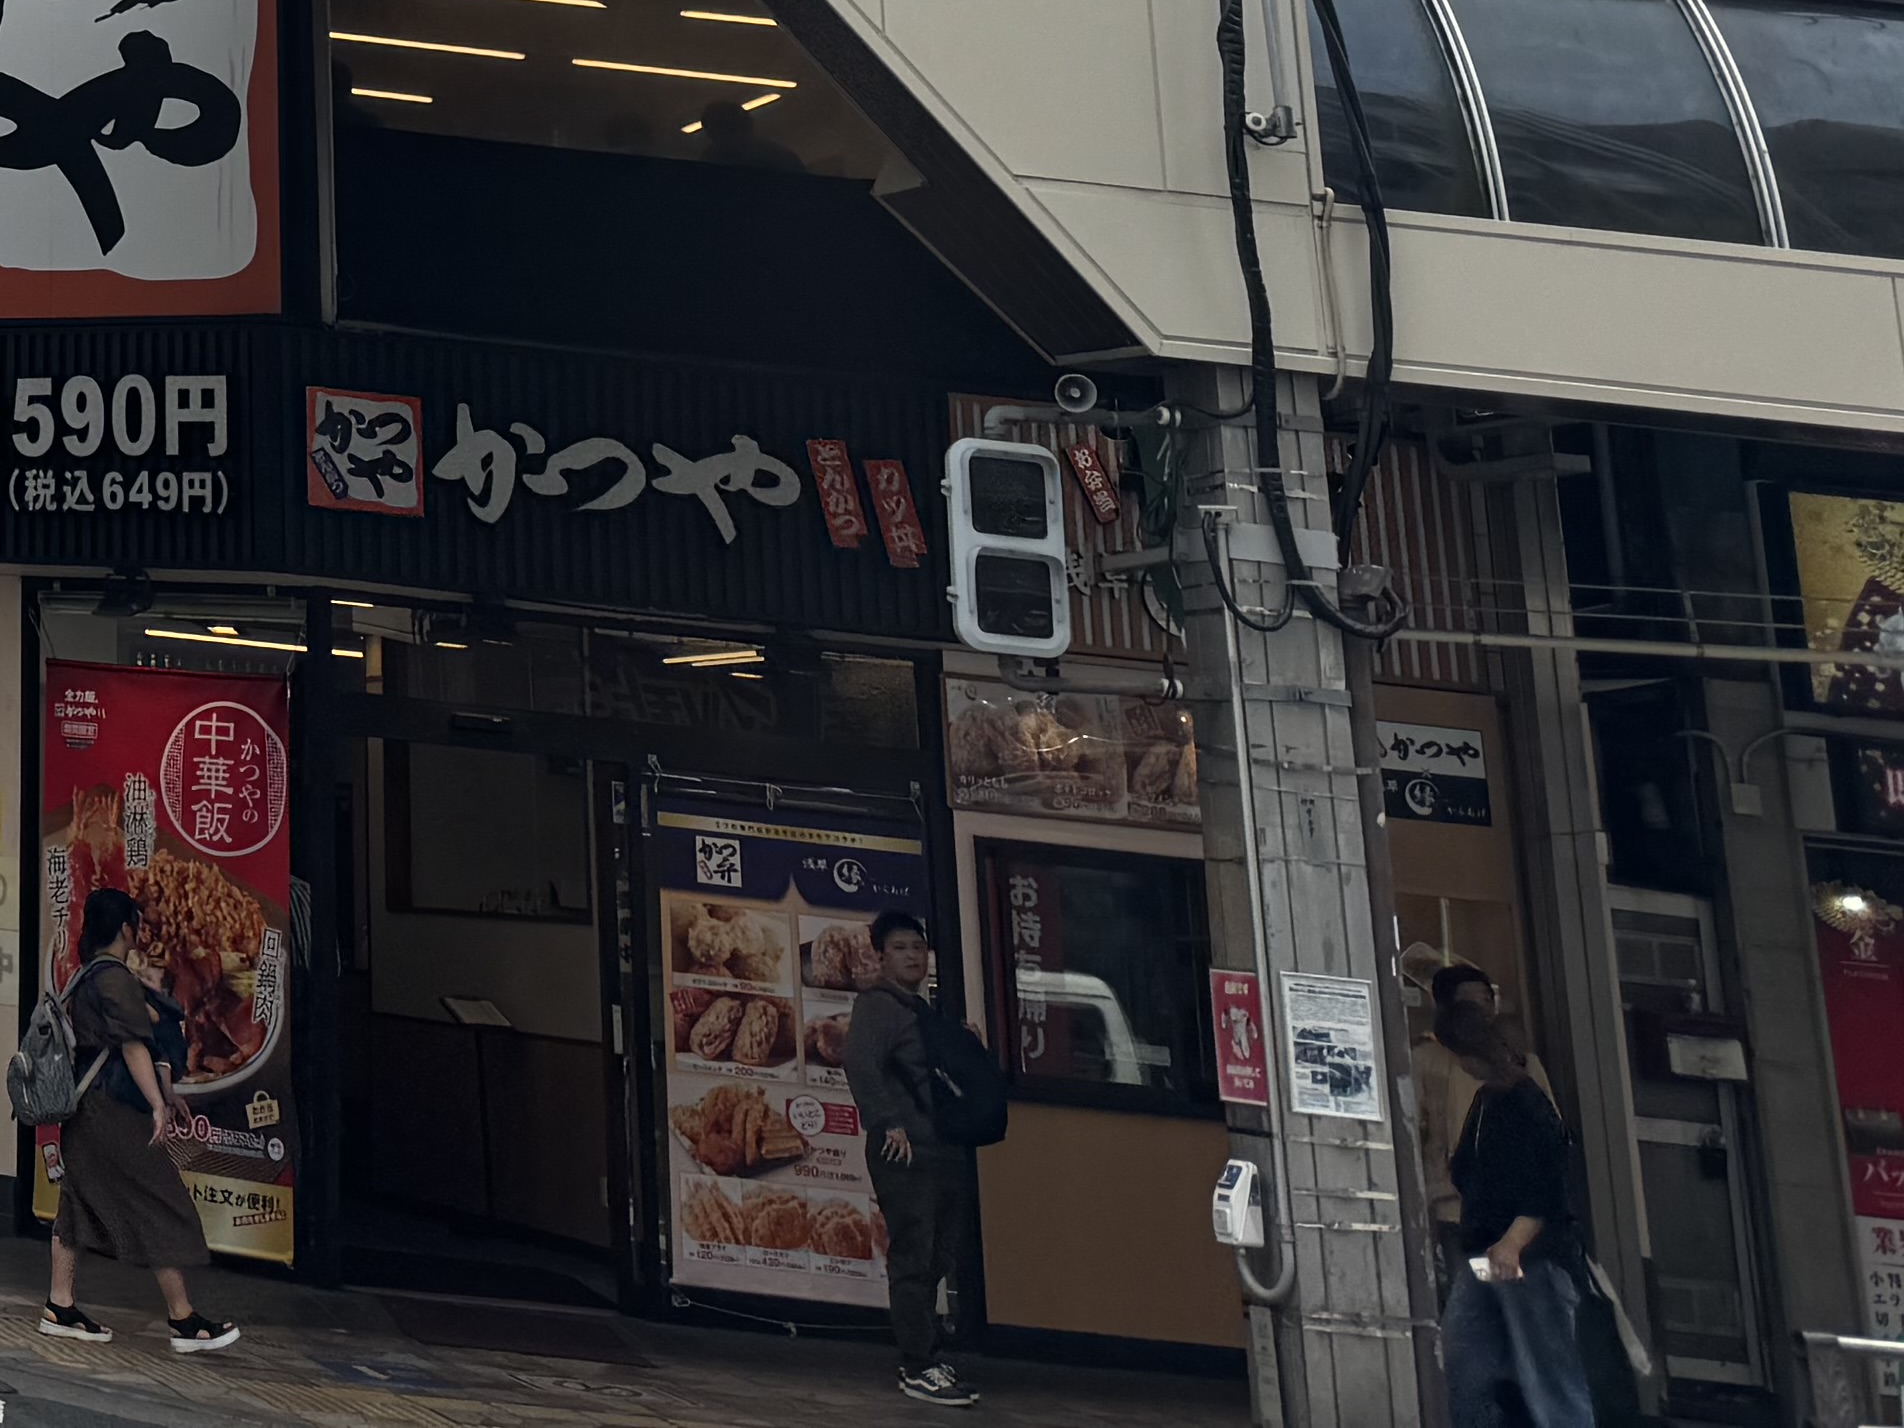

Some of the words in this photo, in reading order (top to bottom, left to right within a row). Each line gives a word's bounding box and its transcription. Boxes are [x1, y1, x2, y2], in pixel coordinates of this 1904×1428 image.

[11, 374, 228, 460] 590円
[8, 469, 229, 514] (税込649円)
[433, 402, 801, 544] かつや
[817, 441, 862, 541] とんかつ
[125, 774, 149, 867] 油淋鶏
[192, 712, 235, 844] 中華飯
[239, 738, 262, 824] かつやの
[45, 846, 72, 957] 海老チリ
